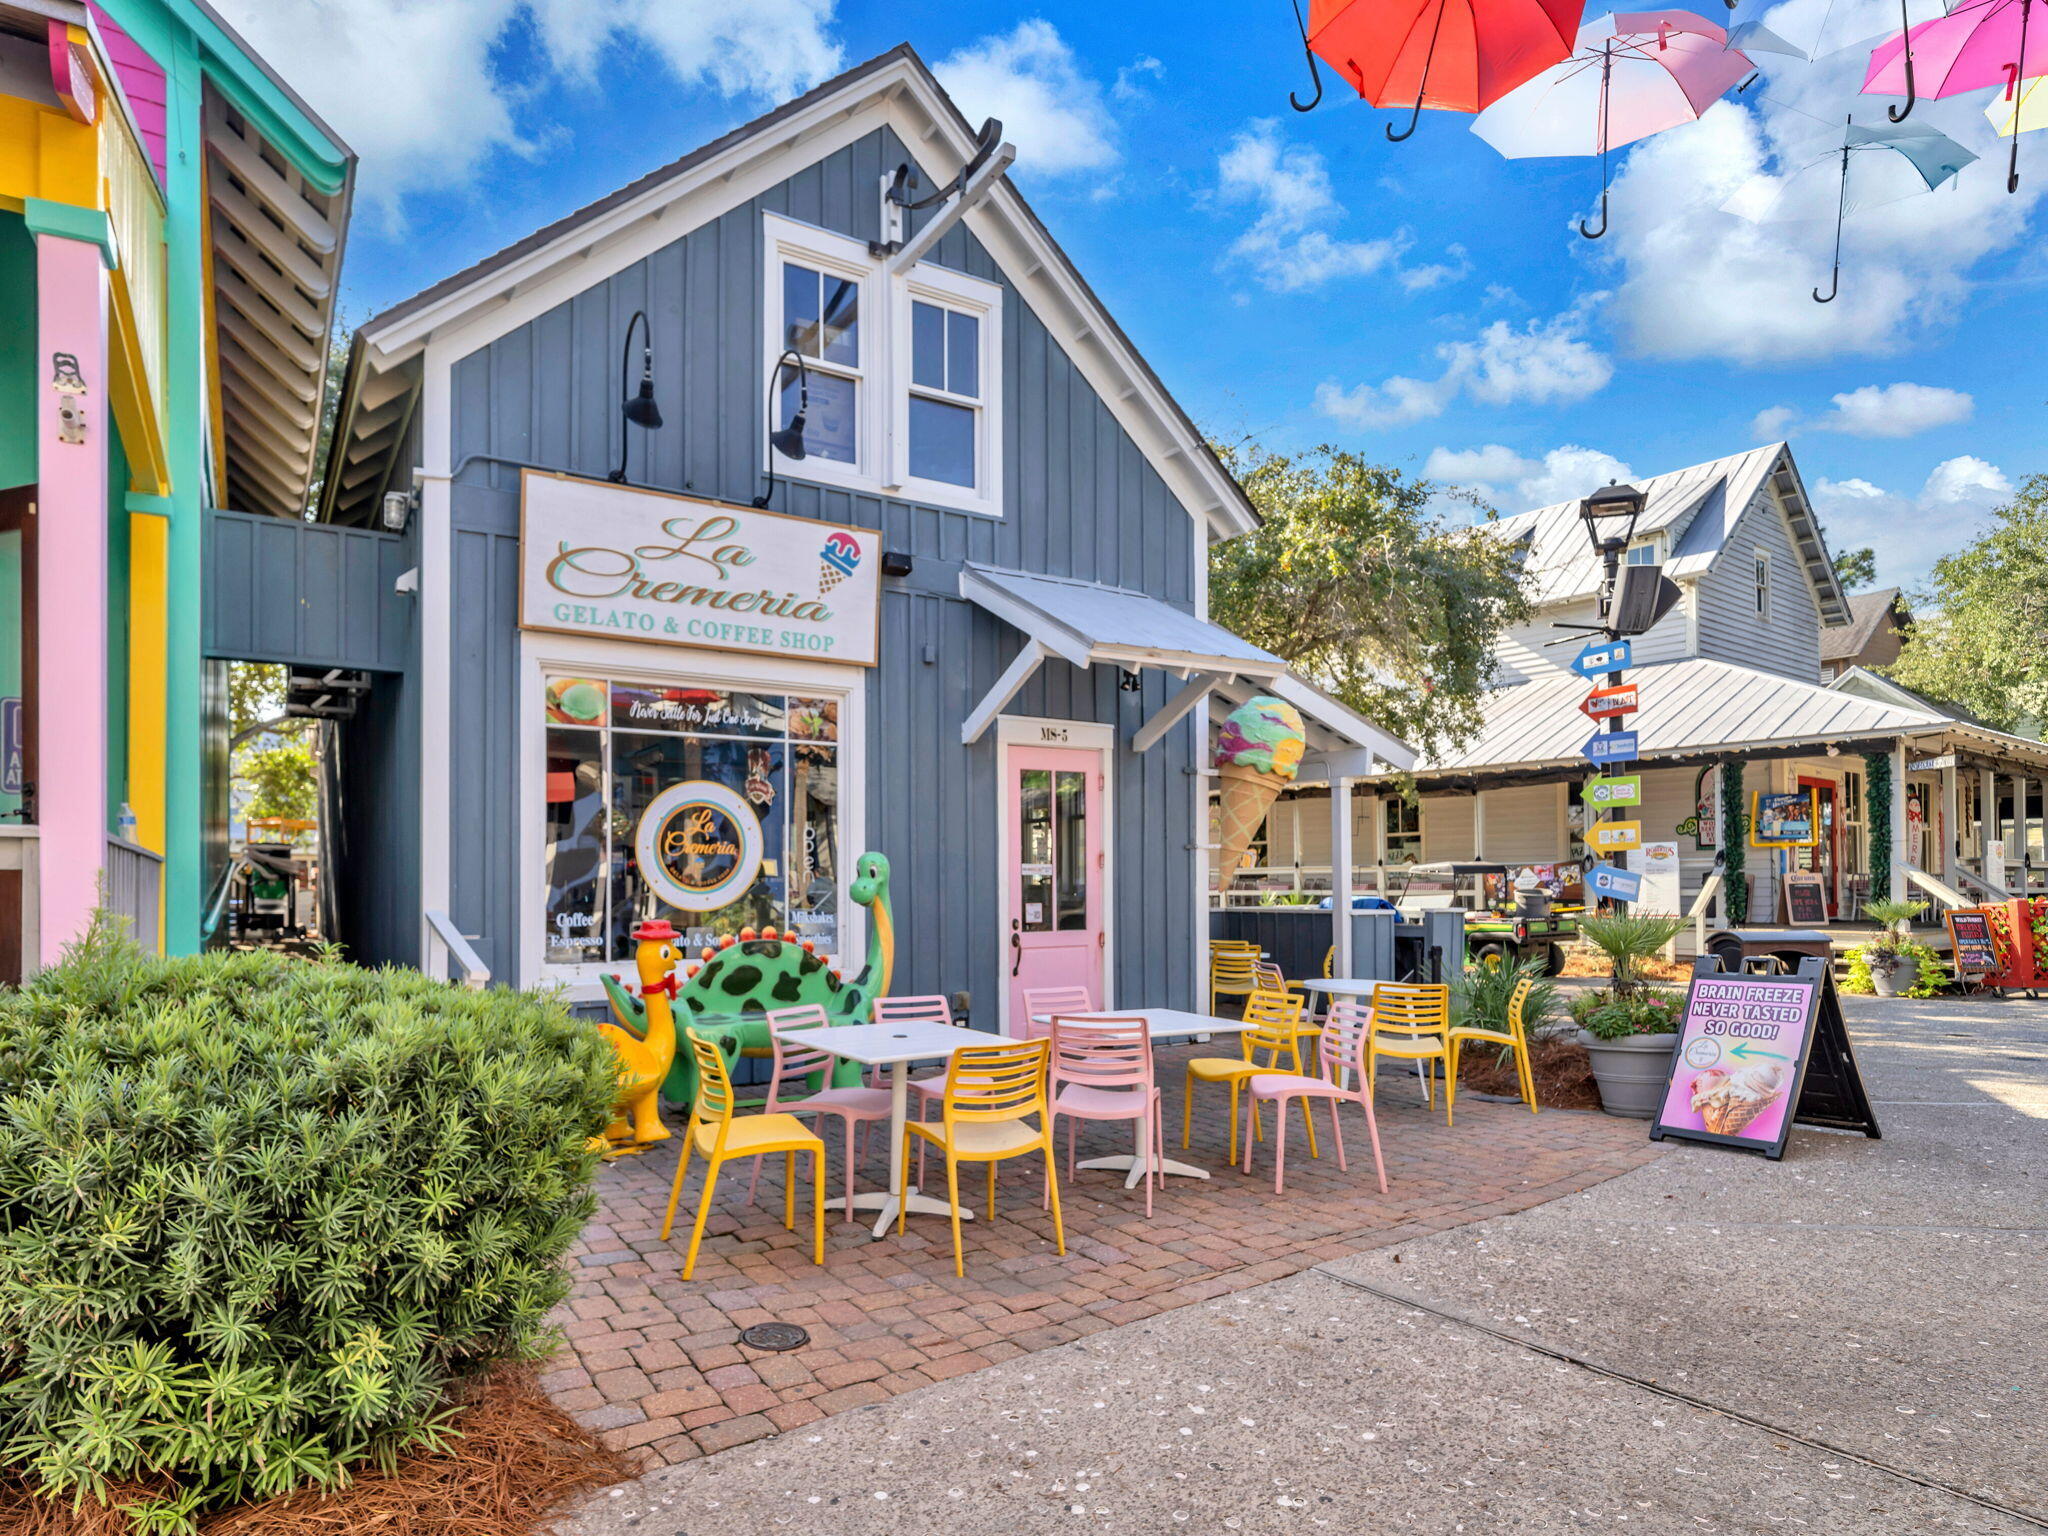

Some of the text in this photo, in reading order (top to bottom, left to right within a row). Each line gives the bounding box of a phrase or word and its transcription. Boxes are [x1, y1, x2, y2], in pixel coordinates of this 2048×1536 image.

[634, 516, 756, 581] La
[546, 541, 834, 623] Cremeria
[553, 602, 836, 652] GELATO & COFFEE SHOP
[1041, 728, 1068, 742] MS-5
[686, 809, 716, 840] La
[664, 831, 739, 857] Cremeria
[1906, 825, 1920, 864] MERR
[556, 912, 594, 928] Coffee
[791, 910, 834, 924] Milkshakes
[550, 935, 604, 949] Espresso
[1698, 984, 1804, 1004] BRAIN FREEZE
[1692, 1001, 1801, 1023] NEVER TASTED
[1704, 1020, 1779, 1040] SO GOOD!
